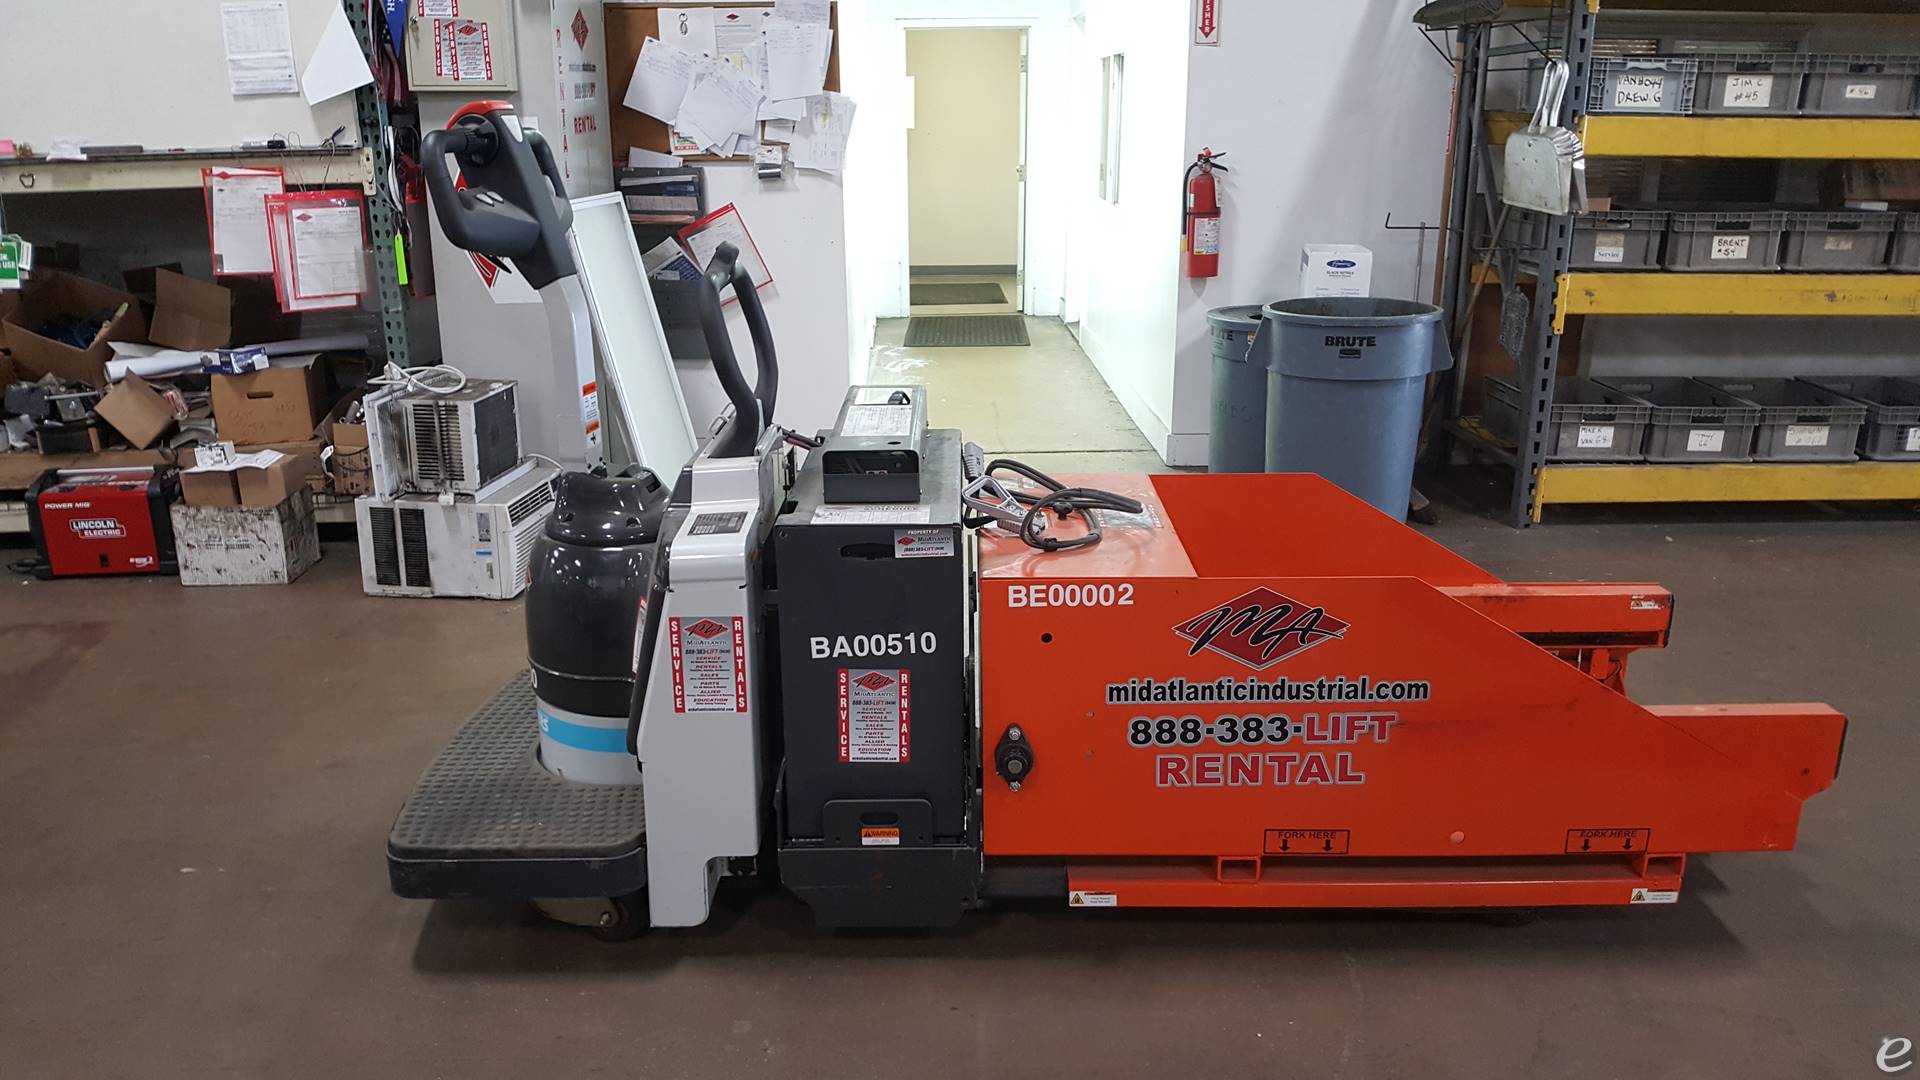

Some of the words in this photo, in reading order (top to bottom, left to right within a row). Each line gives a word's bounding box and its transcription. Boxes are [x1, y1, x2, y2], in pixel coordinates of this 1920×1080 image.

[574, 116, 597, 134] RENTAL
[1324, 336, 1377, 347] BRUTE
[72, 519, 115, 529] LINCOLN
[84, 529, 121, 537] ELECTRIC
[1007, 583, 1134, 608] BE00002
[810, 631, 937, 659] BA00510
[671, 620, 683, 708] SERVICE
[734, 620, 745, 708] RENTALS
[1107, 677, 1429, 703] midatlanticindustrial.com
[1129, 715, 1397, 745] 888-383-LIFT
[1157, 754, 1365, 786] RENTAL
[1278, 831, 1306, 839] FORK
[1309, 831, 1337, 839] HERE
[1580, 830, 1607, 838] FORK
[1610, 830, 1638, 838] HERE
